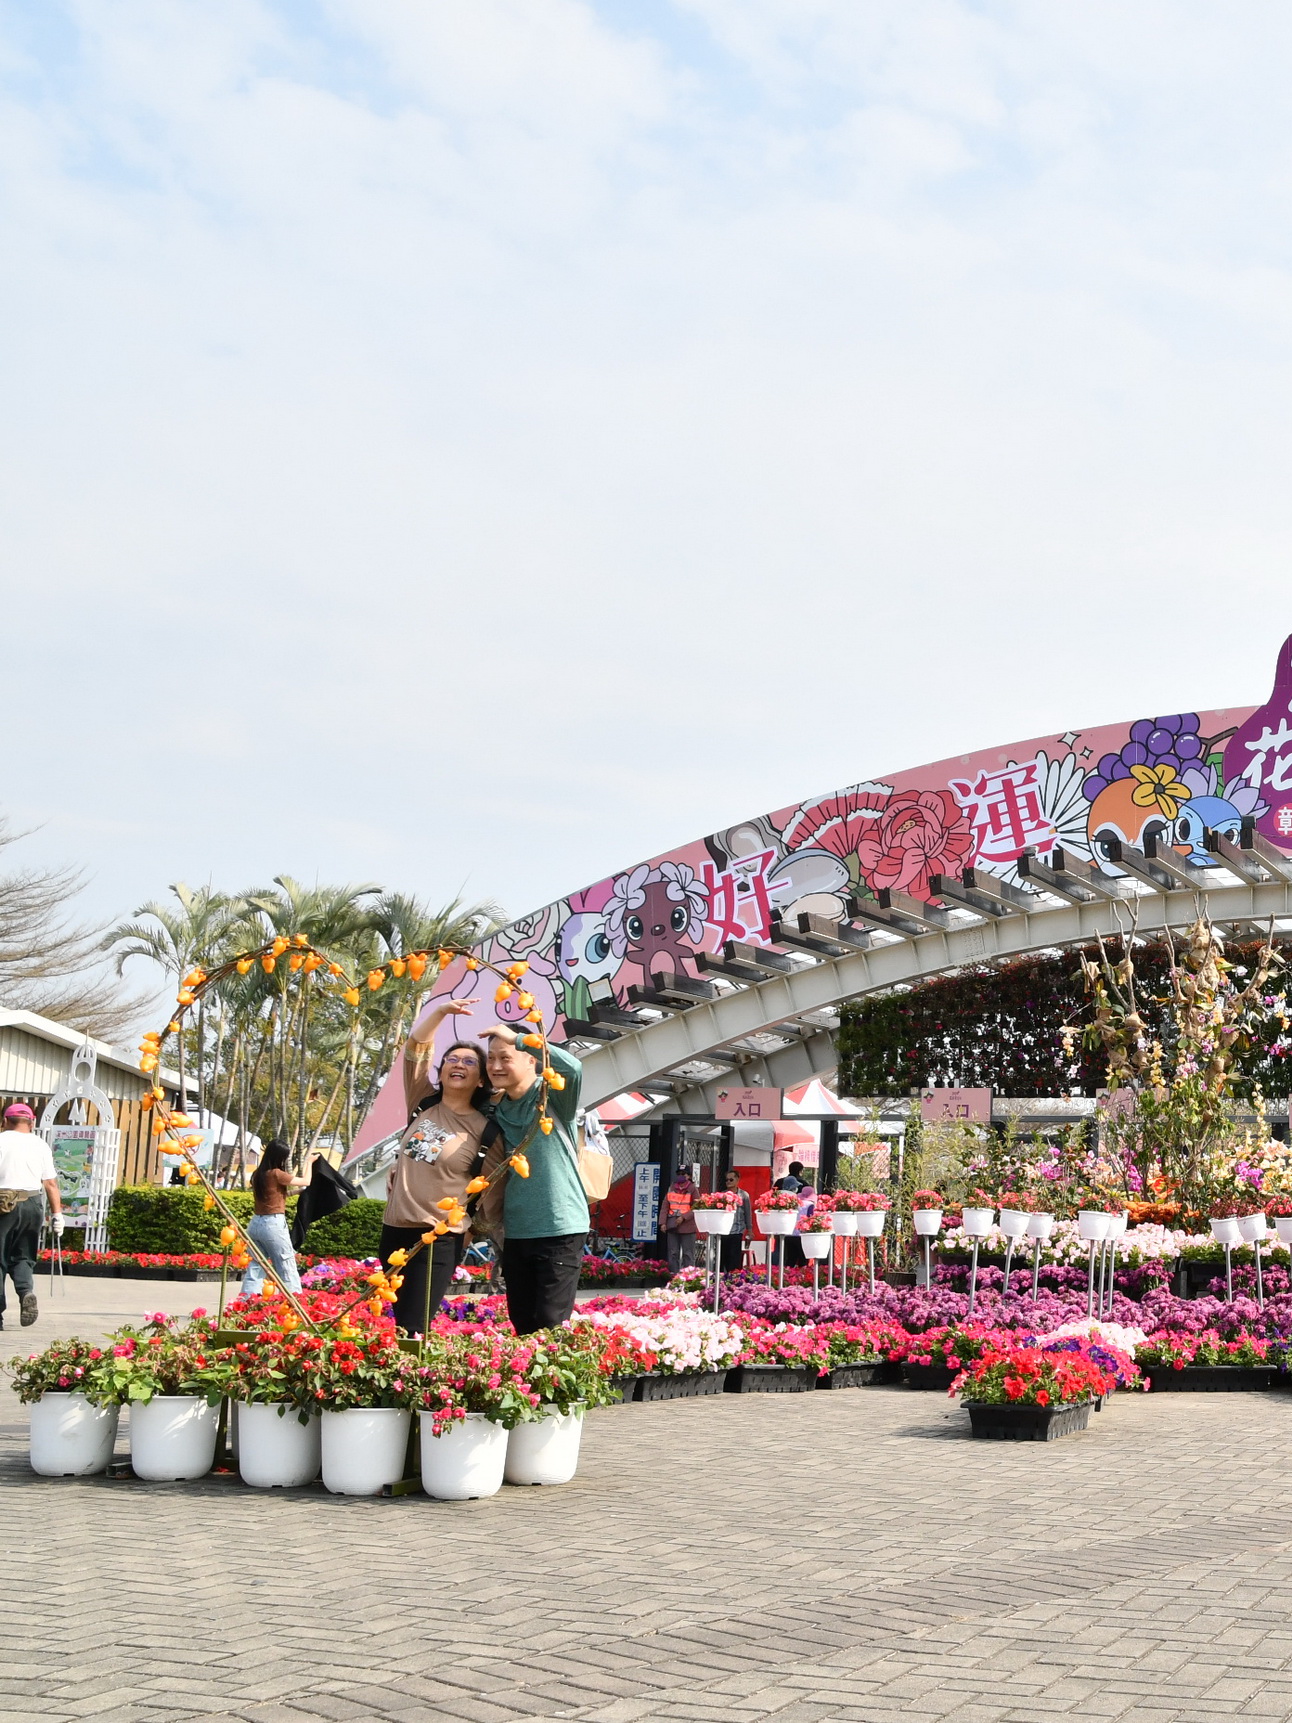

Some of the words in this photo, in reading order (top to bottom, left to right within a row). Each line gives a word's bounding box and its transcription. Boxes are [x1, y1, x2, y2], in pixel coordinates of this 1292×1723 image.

[698, 847, 793, 954] 好
[949, 761, 1058, 869] 運
[733, 1102, 761, 1117] 入口
